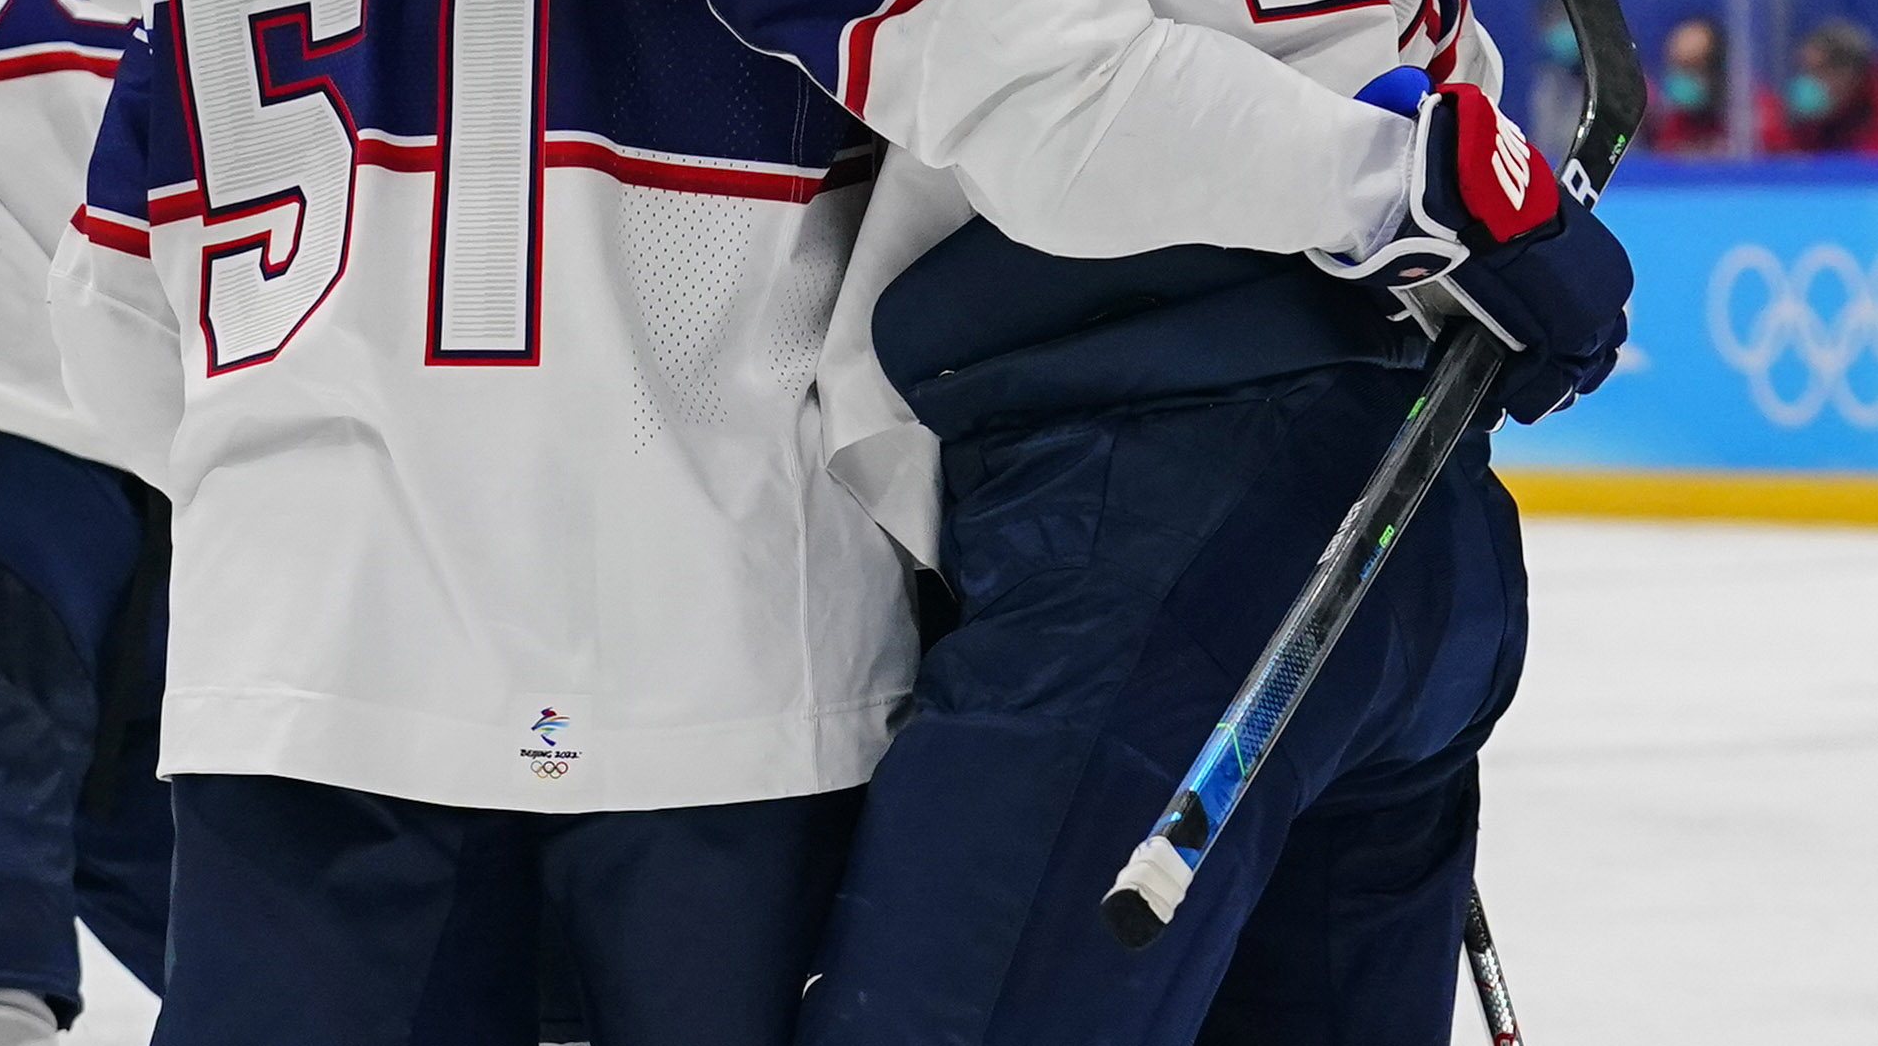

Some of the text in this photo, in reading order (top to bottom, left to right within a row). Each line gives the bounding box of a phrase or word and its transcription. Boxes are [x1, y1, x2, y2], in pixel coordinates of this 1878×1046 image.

[1316, 495, 1368, 565] BAUER
[520, 749, 579, 760] BEIJING 2022
